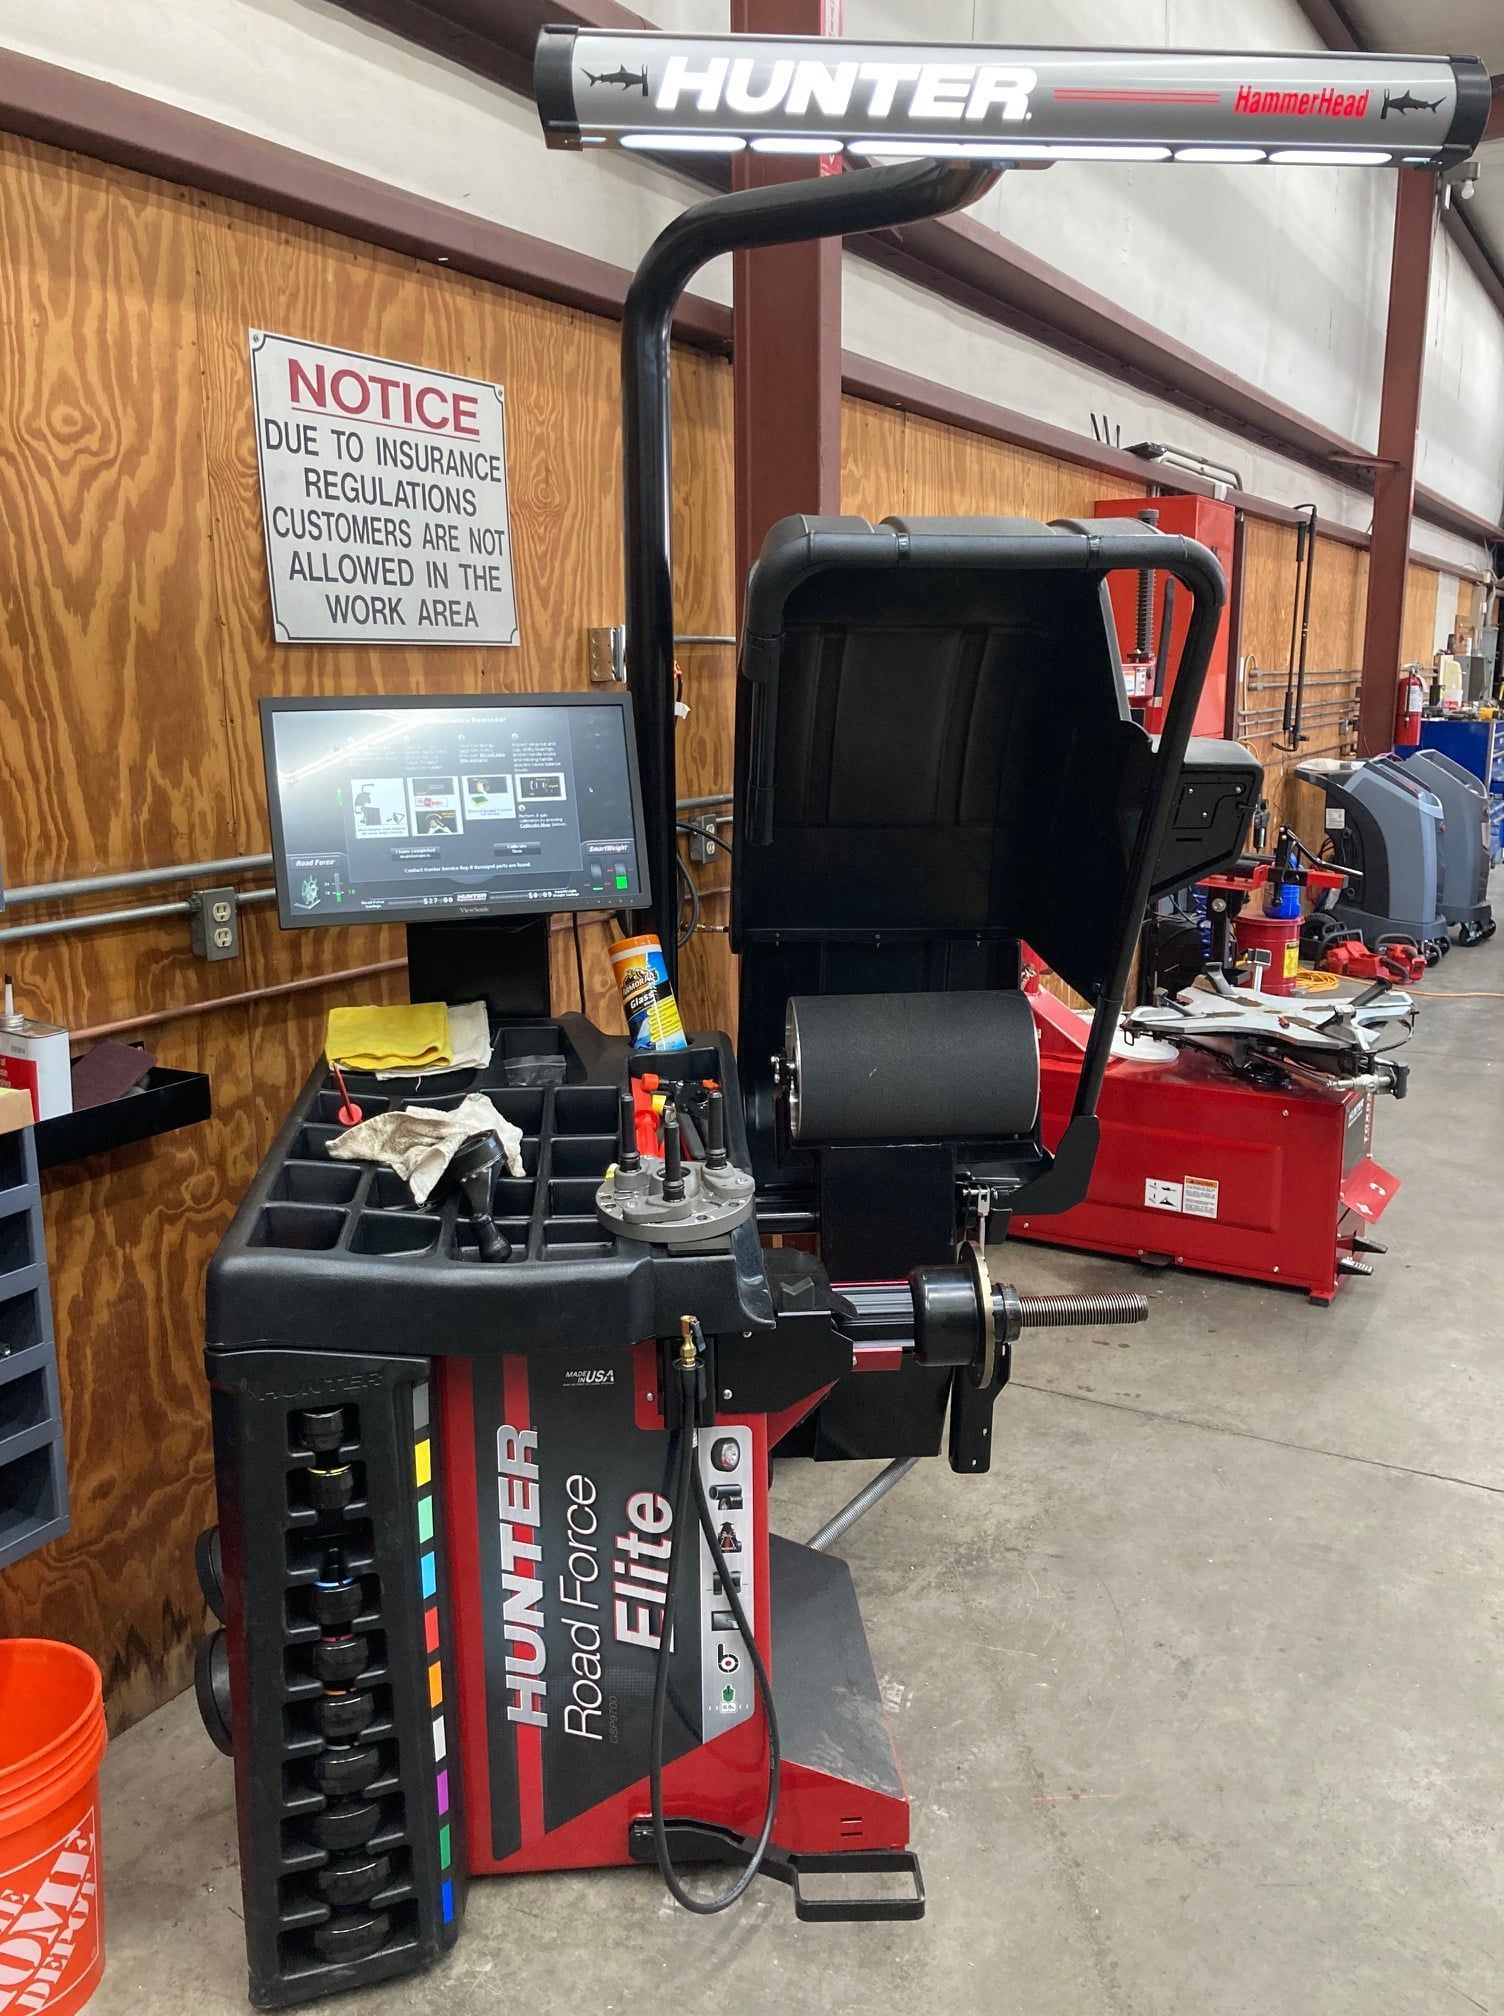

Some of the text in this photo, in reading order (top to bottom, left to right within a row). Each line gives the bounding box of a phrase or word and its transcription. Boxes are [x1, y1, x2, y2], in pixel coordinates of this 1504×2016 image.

[655, 56, 1038, 121] HUNTER
[1235, 85, 1370, 117] HammerHead
[288, 358, 480, 436] NOTICE
[264, 418, 502, 483] DUE TO INSURANCE
[304, 467, 477, 517] REGULATIONS
[272, 506, 505, 556] CUSTOMERS ARE NOT
[289, 550, 502, 592] ALLOWED IN THE
[325, 594, 479, 628] WORK AREA
[296, 859, 313, 867] Road
[565, 1370, 587, 1378] MADE
[585, 1369, 615, 1383] USA
[496, 1424, 549, 1728] HUNTER
[614, 1490, 676, 1653] Elite
[559, 1473, 603, 1740] Road Force
